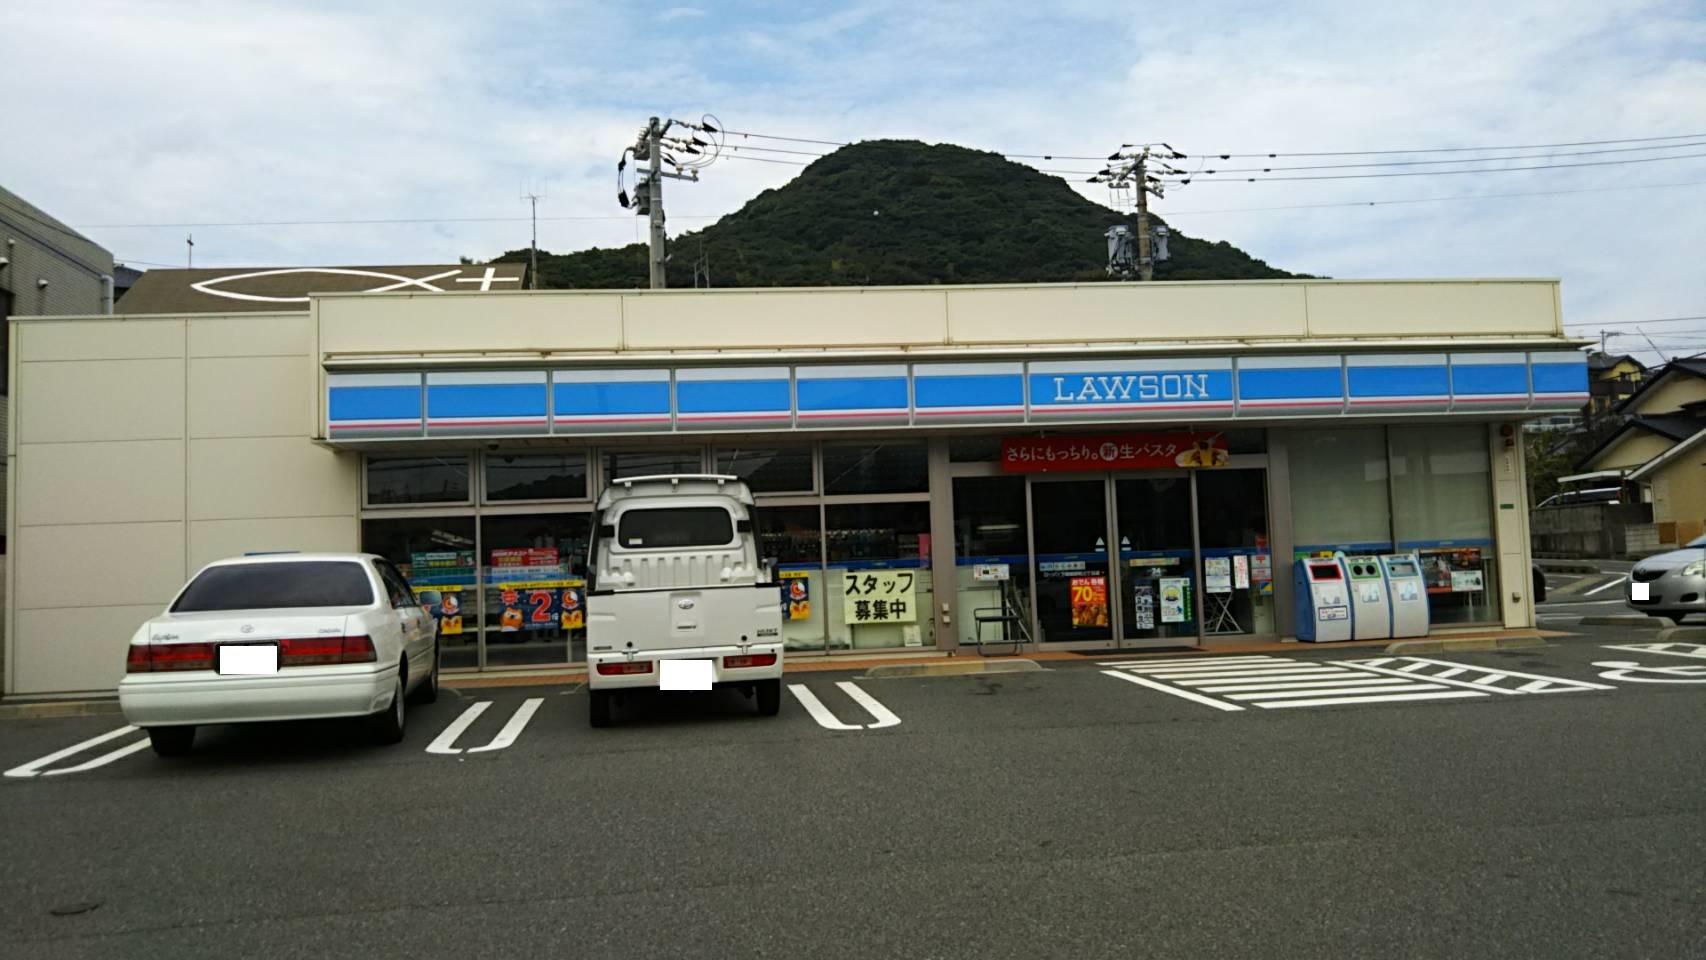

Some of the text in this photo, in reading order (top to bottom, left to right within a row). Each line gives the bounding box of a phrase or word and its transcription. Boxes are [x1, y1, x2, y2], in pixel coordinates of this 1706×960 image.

[1053, 374, 1209, 401] LAWSON
[845, 573, 913, 595] スタッフ
[1072, 586, 1093, 602] 70
[855, 599, 906, 620] 募集中
